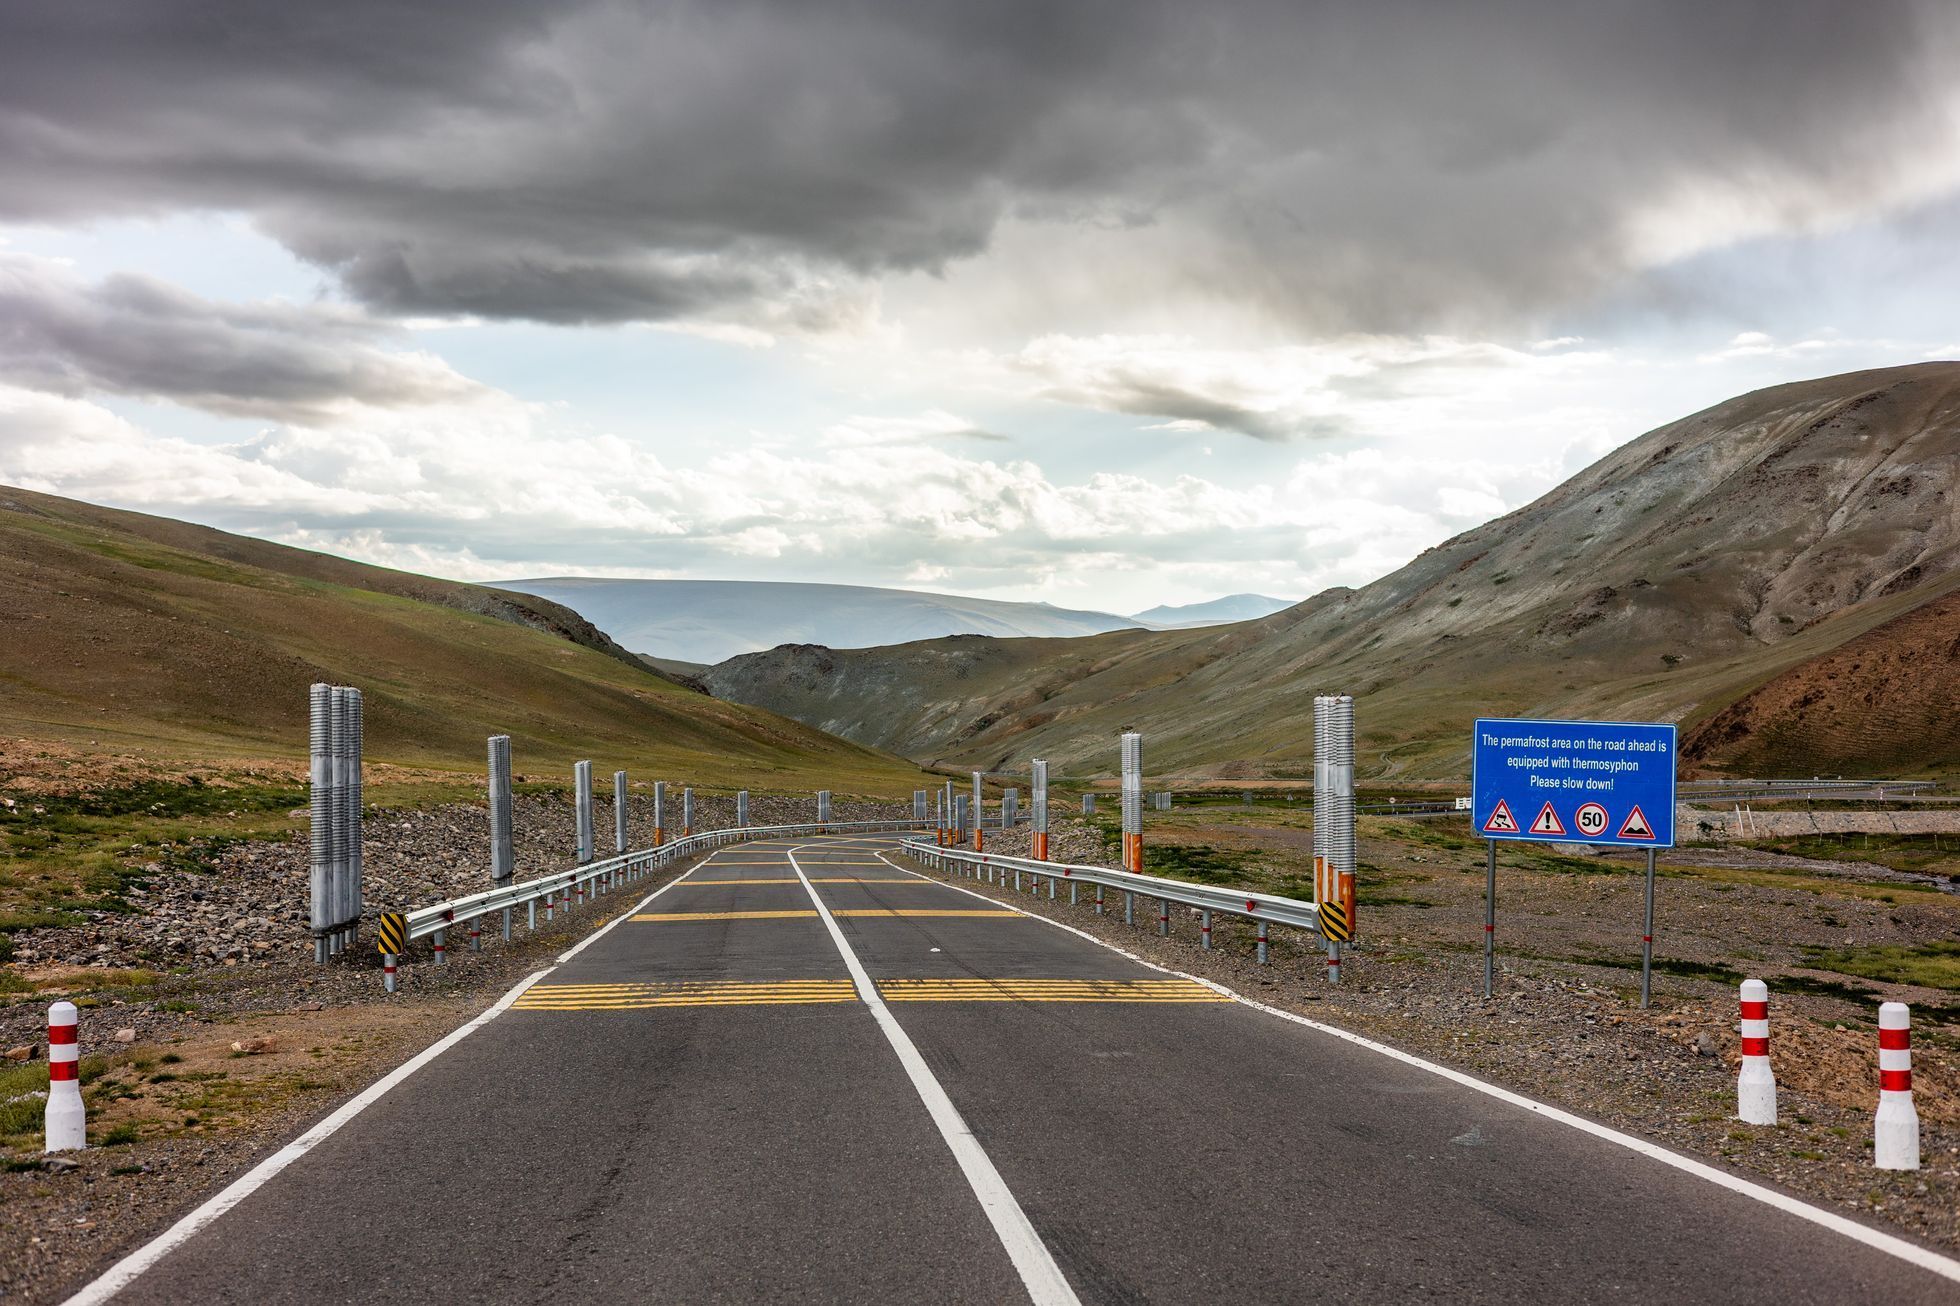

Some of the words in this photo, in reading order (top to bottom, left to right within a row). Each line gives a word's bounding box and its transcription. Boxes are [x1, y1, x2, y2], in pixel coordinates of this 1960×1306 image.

[1482, 734, 1498, 746] The
[1501, 735, 1550, 749] permafrost
[1552, 739, 1571, 749] area
[1574, 739, 1586, 749] on
[1588, 738, 1602, 750] the
[1605, 739, 1626, 751] road
[1628, 739, 1656, 752] ahead
[1659, 740, 1667, 752] is
[1507, 755, 1549, 769] equipped
[1552, 756, 1570, 768] with
[1573, 758, 1639, 773] thermosyphon
[1530, 775, 1560, 788] Please
[1563, 776, 1584, 789] slow
[1586, 777, 1614, 790] down!
[1581, 812, 1603, 828] 50
